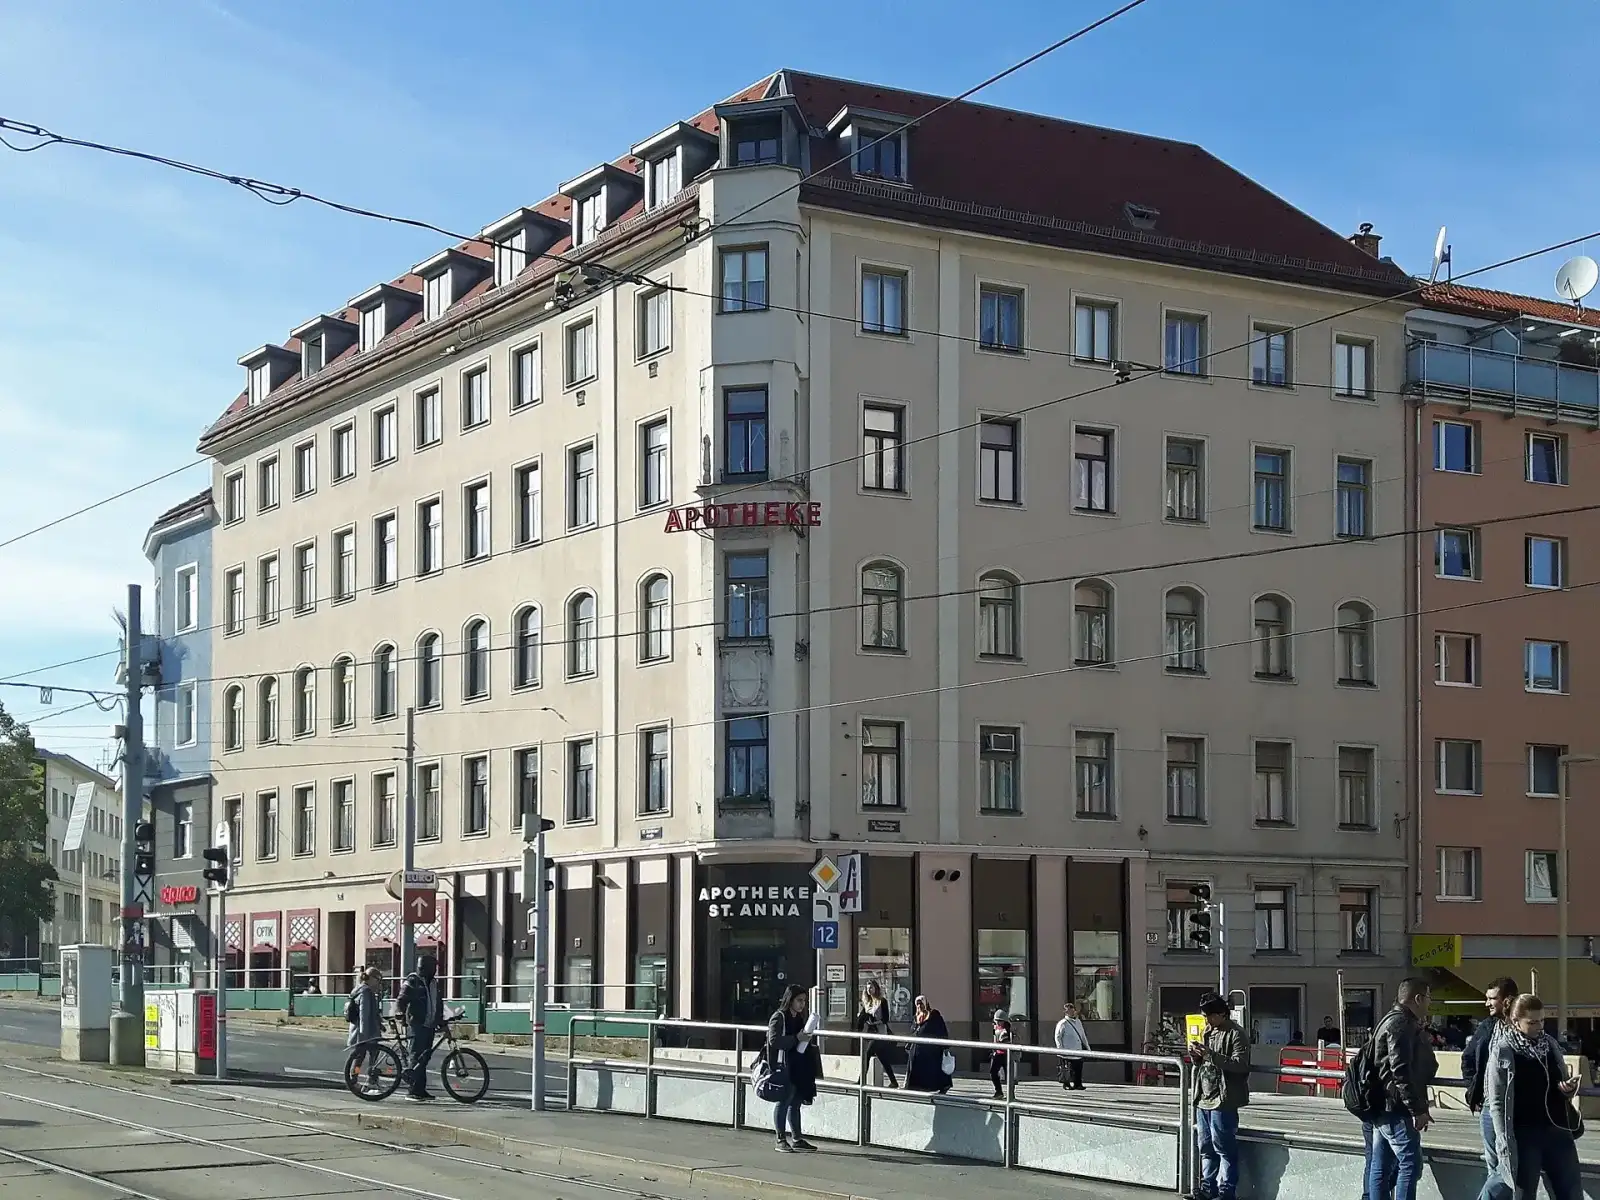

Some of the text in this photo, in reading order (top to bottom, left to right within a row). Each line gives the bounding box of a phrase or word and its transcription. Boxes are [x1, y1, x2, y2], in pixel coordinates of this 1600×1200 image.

[664, 502, 822, 533] APOTHEKE
[698, 886, 809, 901] APOTHEKE
[708, 903, 800, 918] ST. ANNA
[817, 926, 834, 943] 12
